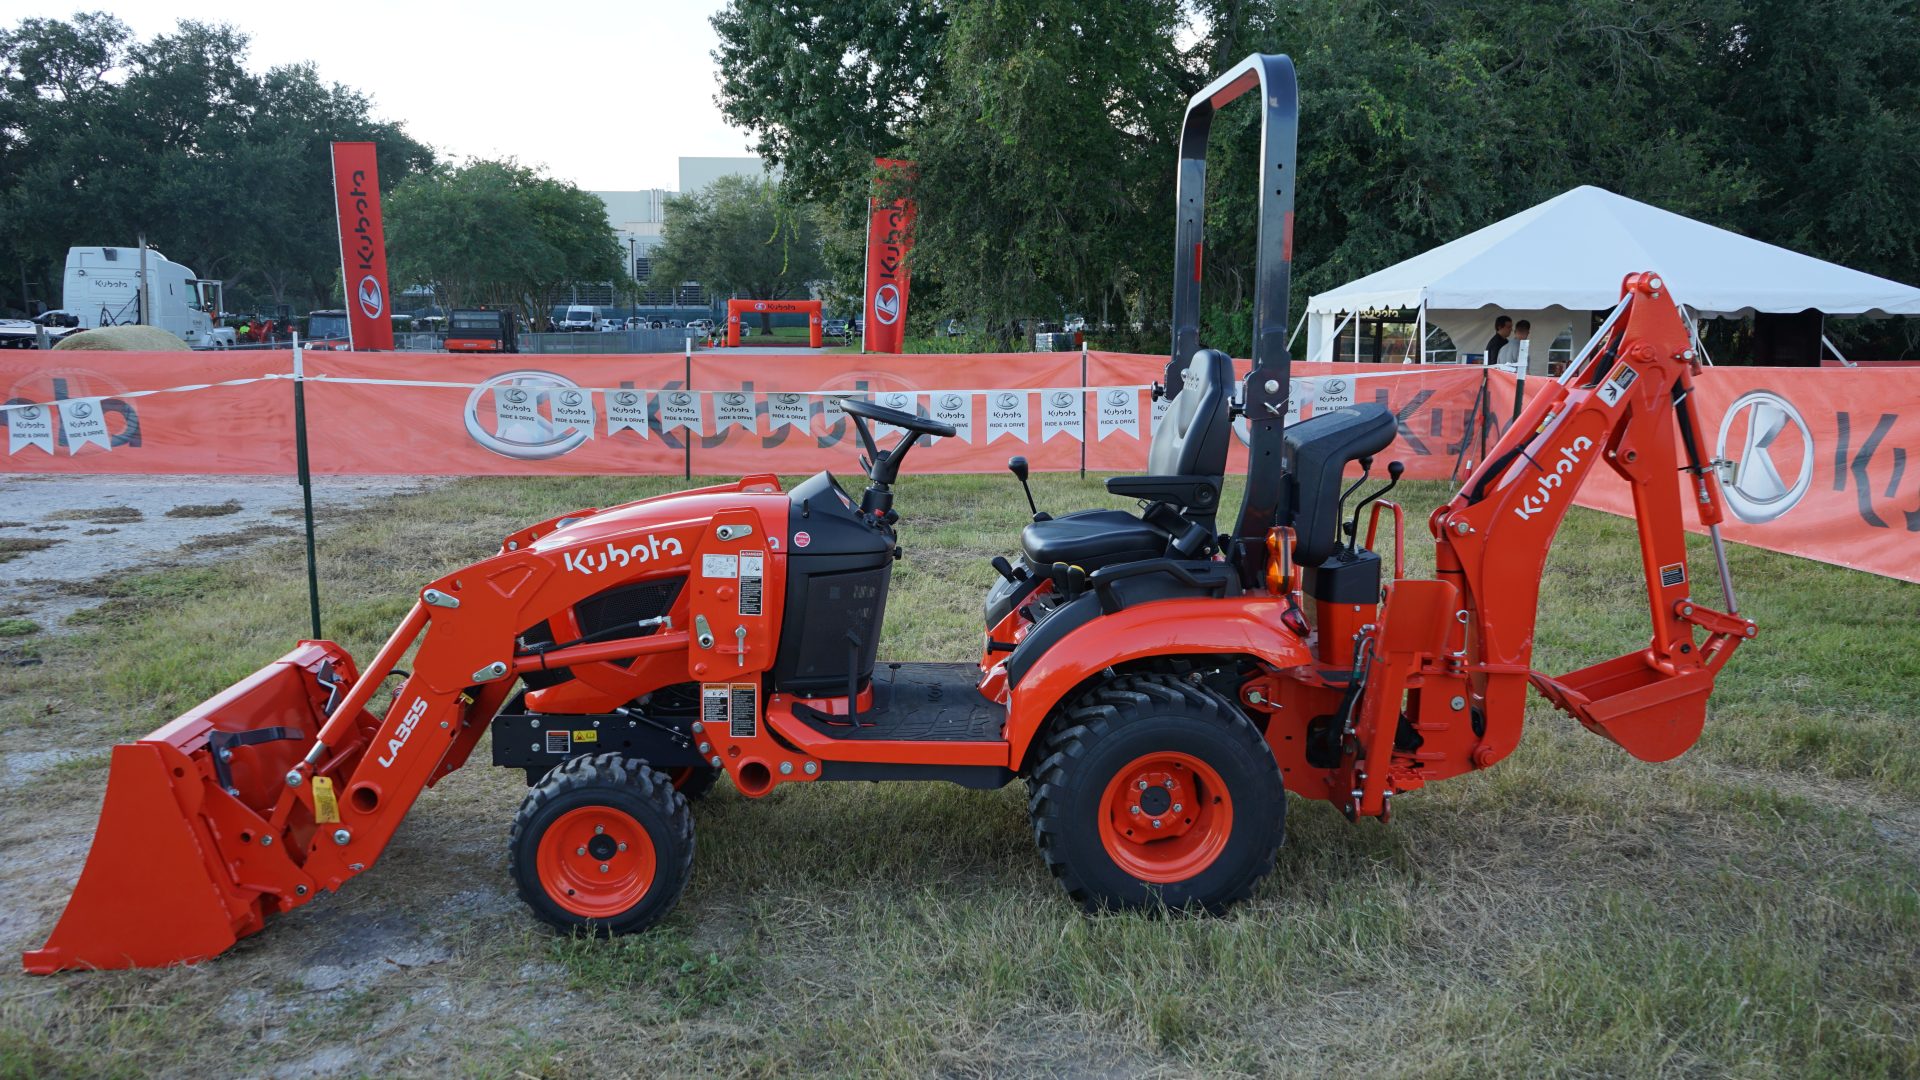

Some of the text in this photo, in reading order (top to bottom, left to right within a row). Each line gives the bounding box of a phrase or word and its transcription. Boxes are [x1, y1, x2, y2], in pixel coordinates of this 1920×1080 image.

[349, 170, 375, 270] Kubota
[880, 203, 905, 279] Kubot
[95, 280, 128, 288] Kubota
[502, 404, 531, 413] Kubota
[557, 407, 586, 416] Kubota
[16, 421, 46, 429] Kubota
[69, 420, 98, 428] Kubota
[1513, 436, 1593, 520] Kubota
[563, 534, 683, 575] Kubota
[377, 696, 429, 768] LA355
